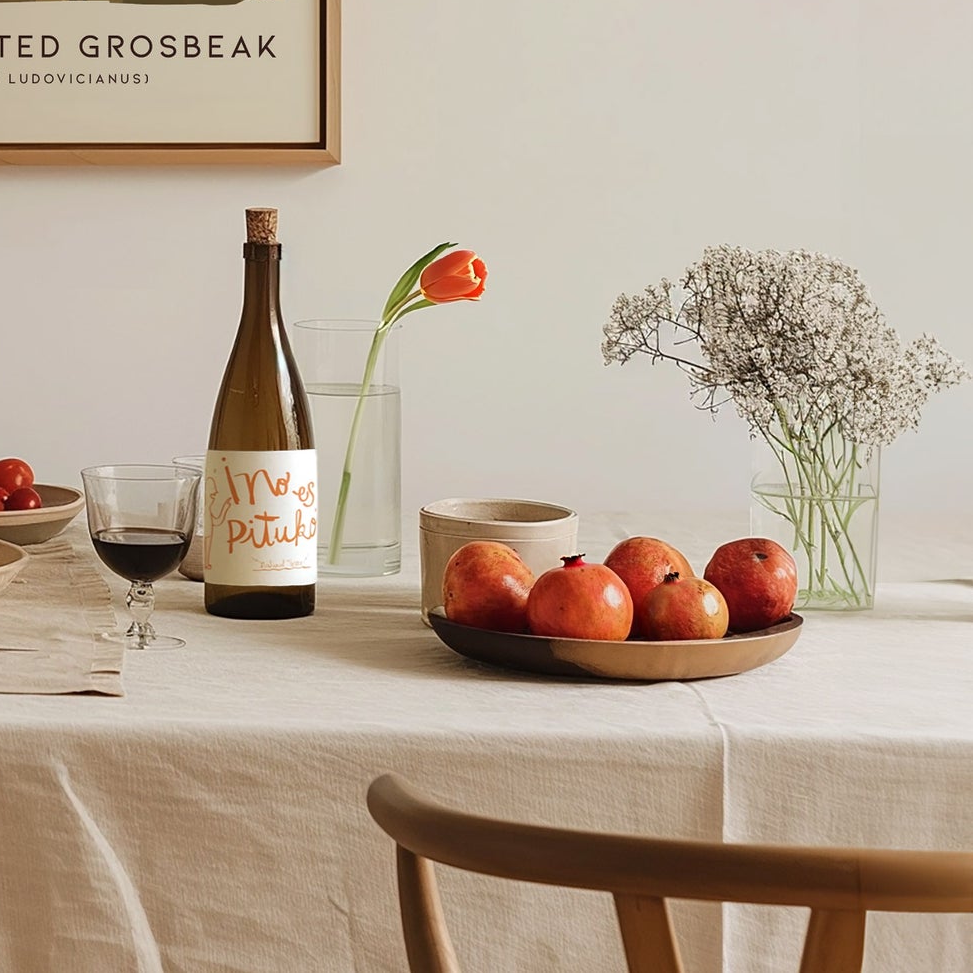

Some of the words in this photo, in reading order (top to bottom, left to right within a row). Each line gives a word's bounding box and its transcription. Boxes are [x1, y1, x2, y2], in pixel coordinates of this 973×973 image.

[78, 34, 277, 59] GROSBEAK
[8, 73, 150, 85] LUDOVICIANUS)
[292, 481, 314, 507] es
